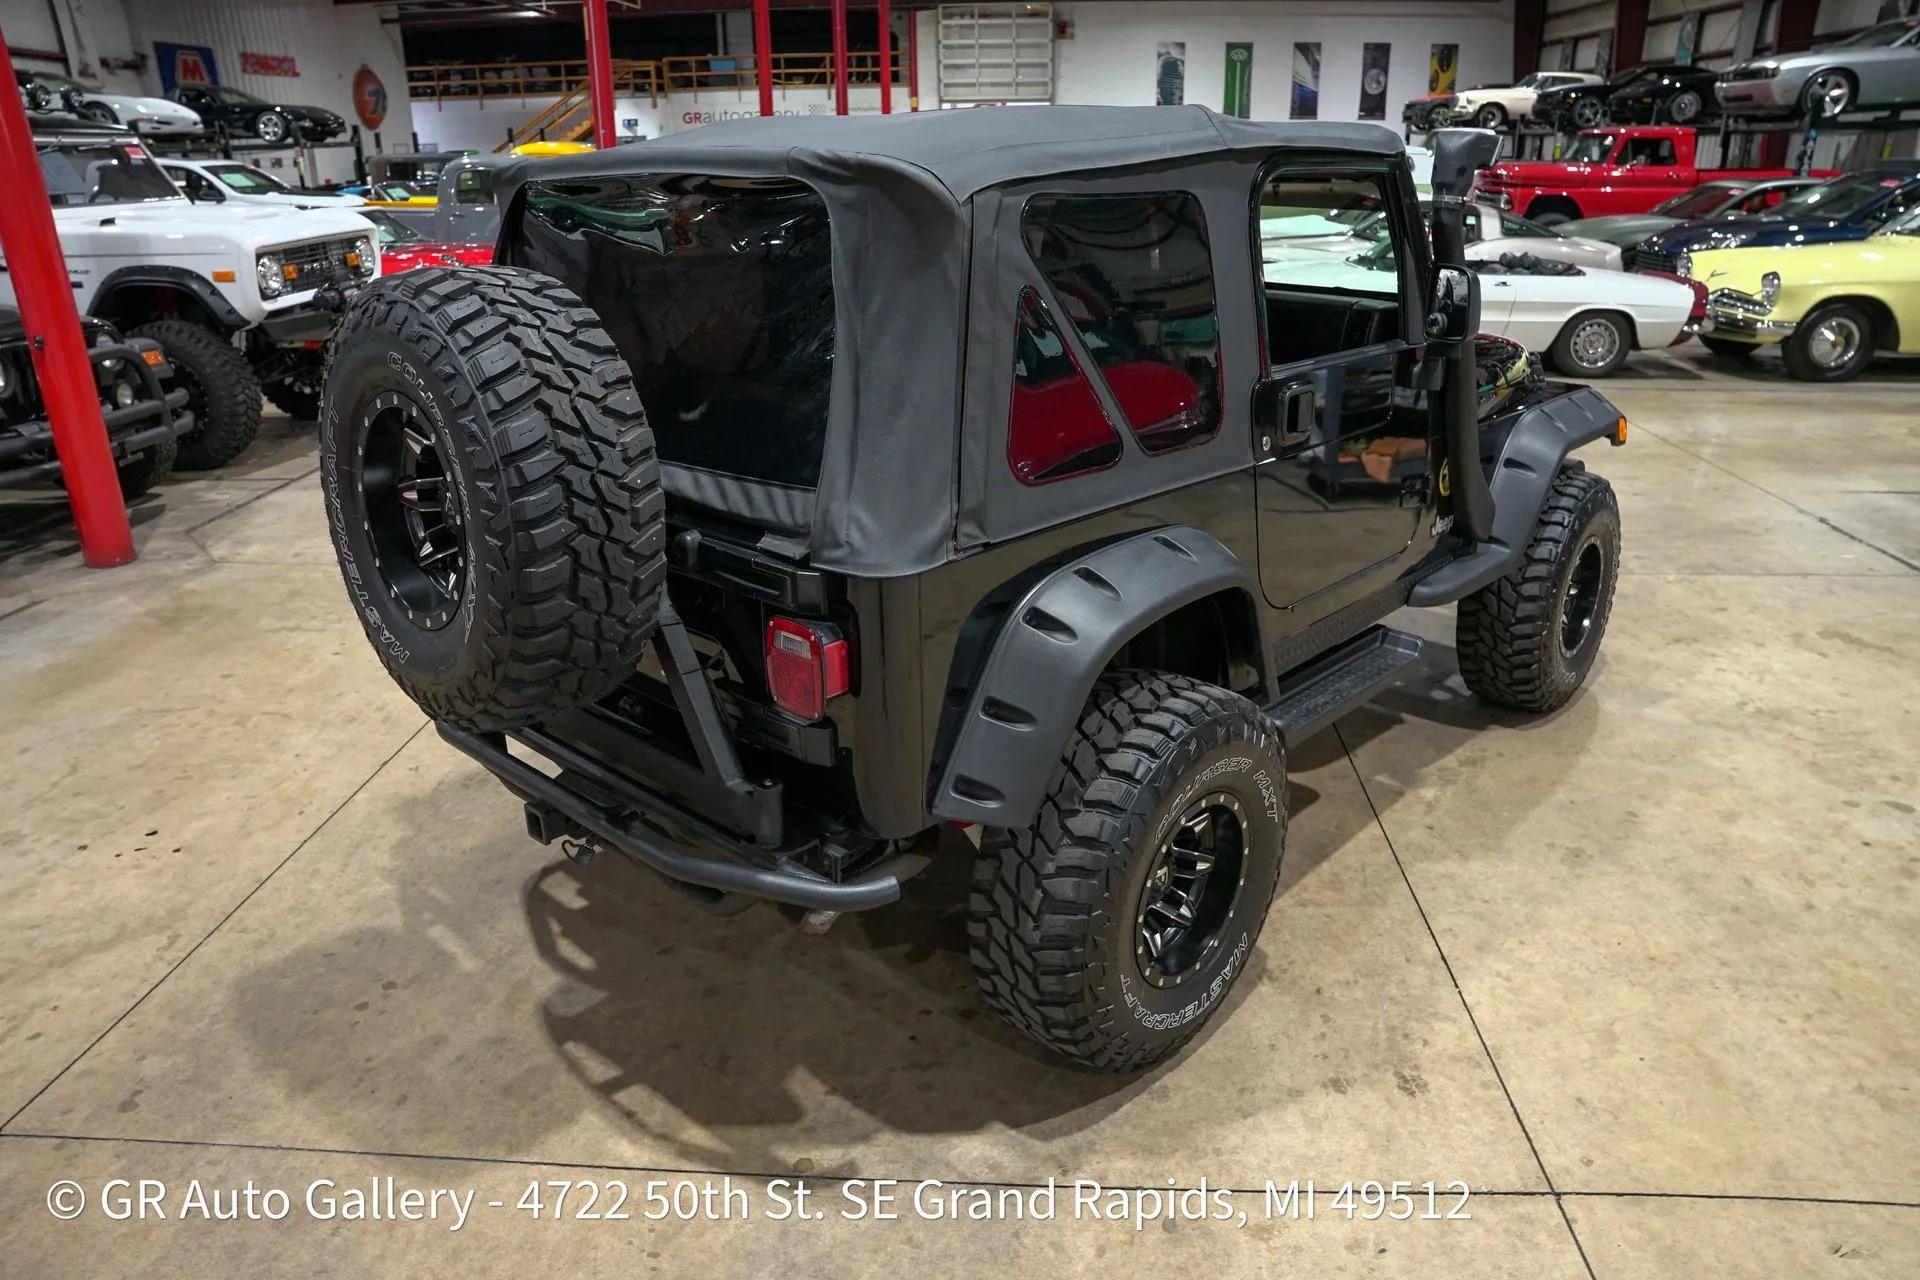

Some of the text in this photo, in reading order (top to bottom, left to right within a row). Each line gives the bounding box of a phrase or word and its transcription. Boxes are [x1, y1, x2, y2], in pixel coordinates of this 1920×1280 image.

[1431, 514, 1455, 538] Jeep
[1252, 769, 1279, 824] MXT
[1119, 931, 1249, 1031] MASTERCRAFT
